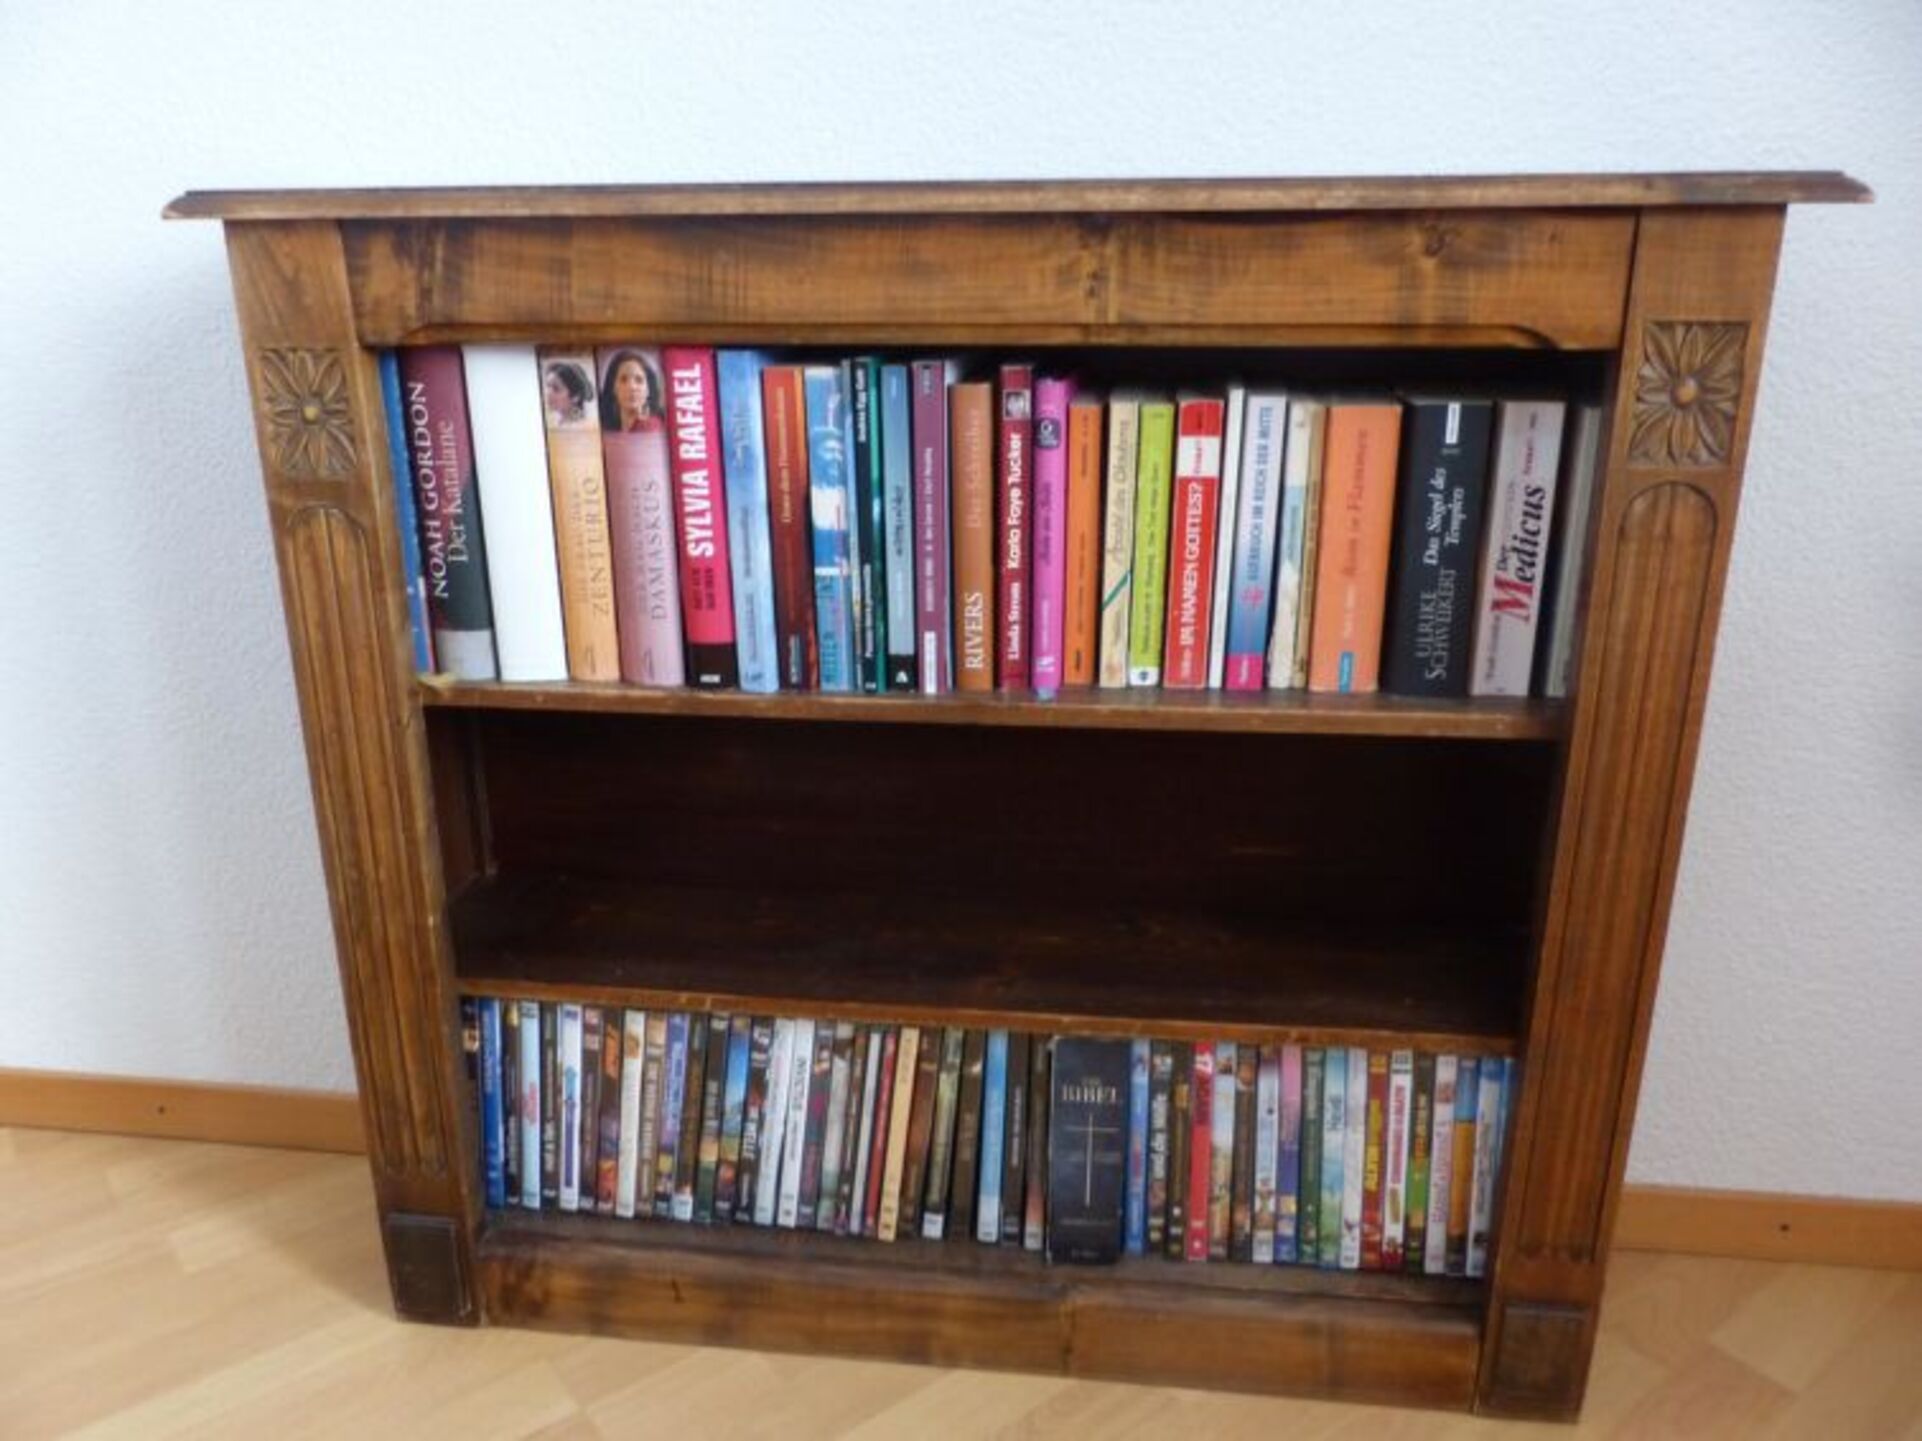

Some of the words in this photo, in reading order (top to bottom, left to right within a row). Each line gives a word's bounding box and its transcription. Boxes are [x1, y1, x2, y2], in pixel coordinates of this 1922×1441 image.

[408, 380, 438, 510] GORDON
[673, 363, 707, 460] RAFAEL
[436, 421, 464, 514] Katalane
[1008, 432, 1021, 484] Tucker
[1429, 466, 1447, 489] des
[684, 470, 714, 558] SYLVIA
[967, 496, 982, 528] Der
[1008, 488, 1024, 525] Faye
[1185, 481, 1202, 560] GOTTES?
[1426, 493, 1445, 533] Siegel
[424, 520, 449, 599] NOAH
[447, 524, 469, 562] Der
[583, 477, 609, 616] ZENTURIO
[645, 480, 668, 620] DAMASKUS
[1008, 528, 1021, 569] Karla
[1422, 535, 1440, 565] Das
[1491, 484, 1546, 622] Medicus
[1495, 544, 1511, 572] Der
[1184, 564, 1199, 623] NAMEN
[1414, 589, 1437, 657] ULRIKE
[1424, 567, 1457, 679] SCHWEIKERT
[965, 592, 984, 668] RIVERS
[1008, 624, 1021, 660] Linda
